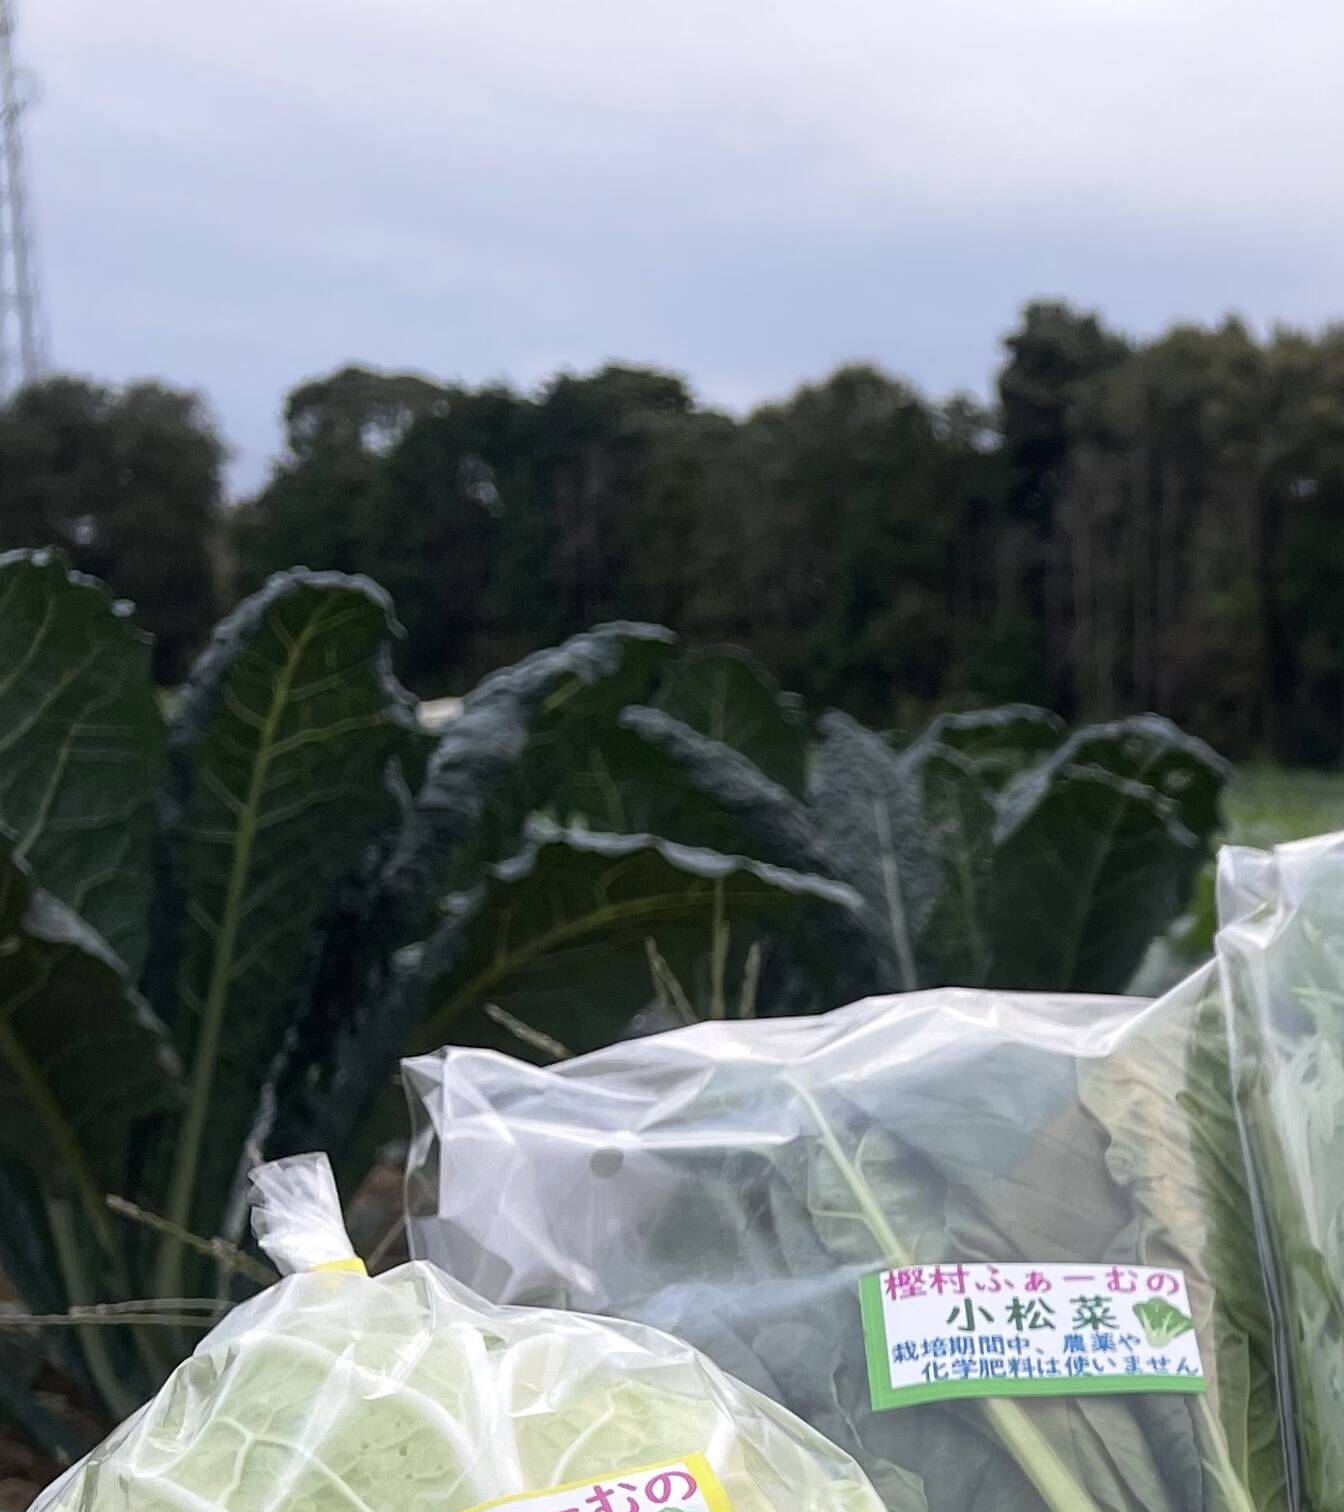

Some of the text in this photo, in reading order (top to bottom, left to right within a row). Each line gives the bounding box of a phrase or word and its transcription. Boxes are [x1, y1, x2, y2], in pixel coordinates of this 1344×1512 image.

[884, 1263, 1181, 1301] 樫村ふぁーむの
[946, 1295, 1120, 1332] 小松菜
[921, 1355, 1199, 1383] 化学肥料は使いません
